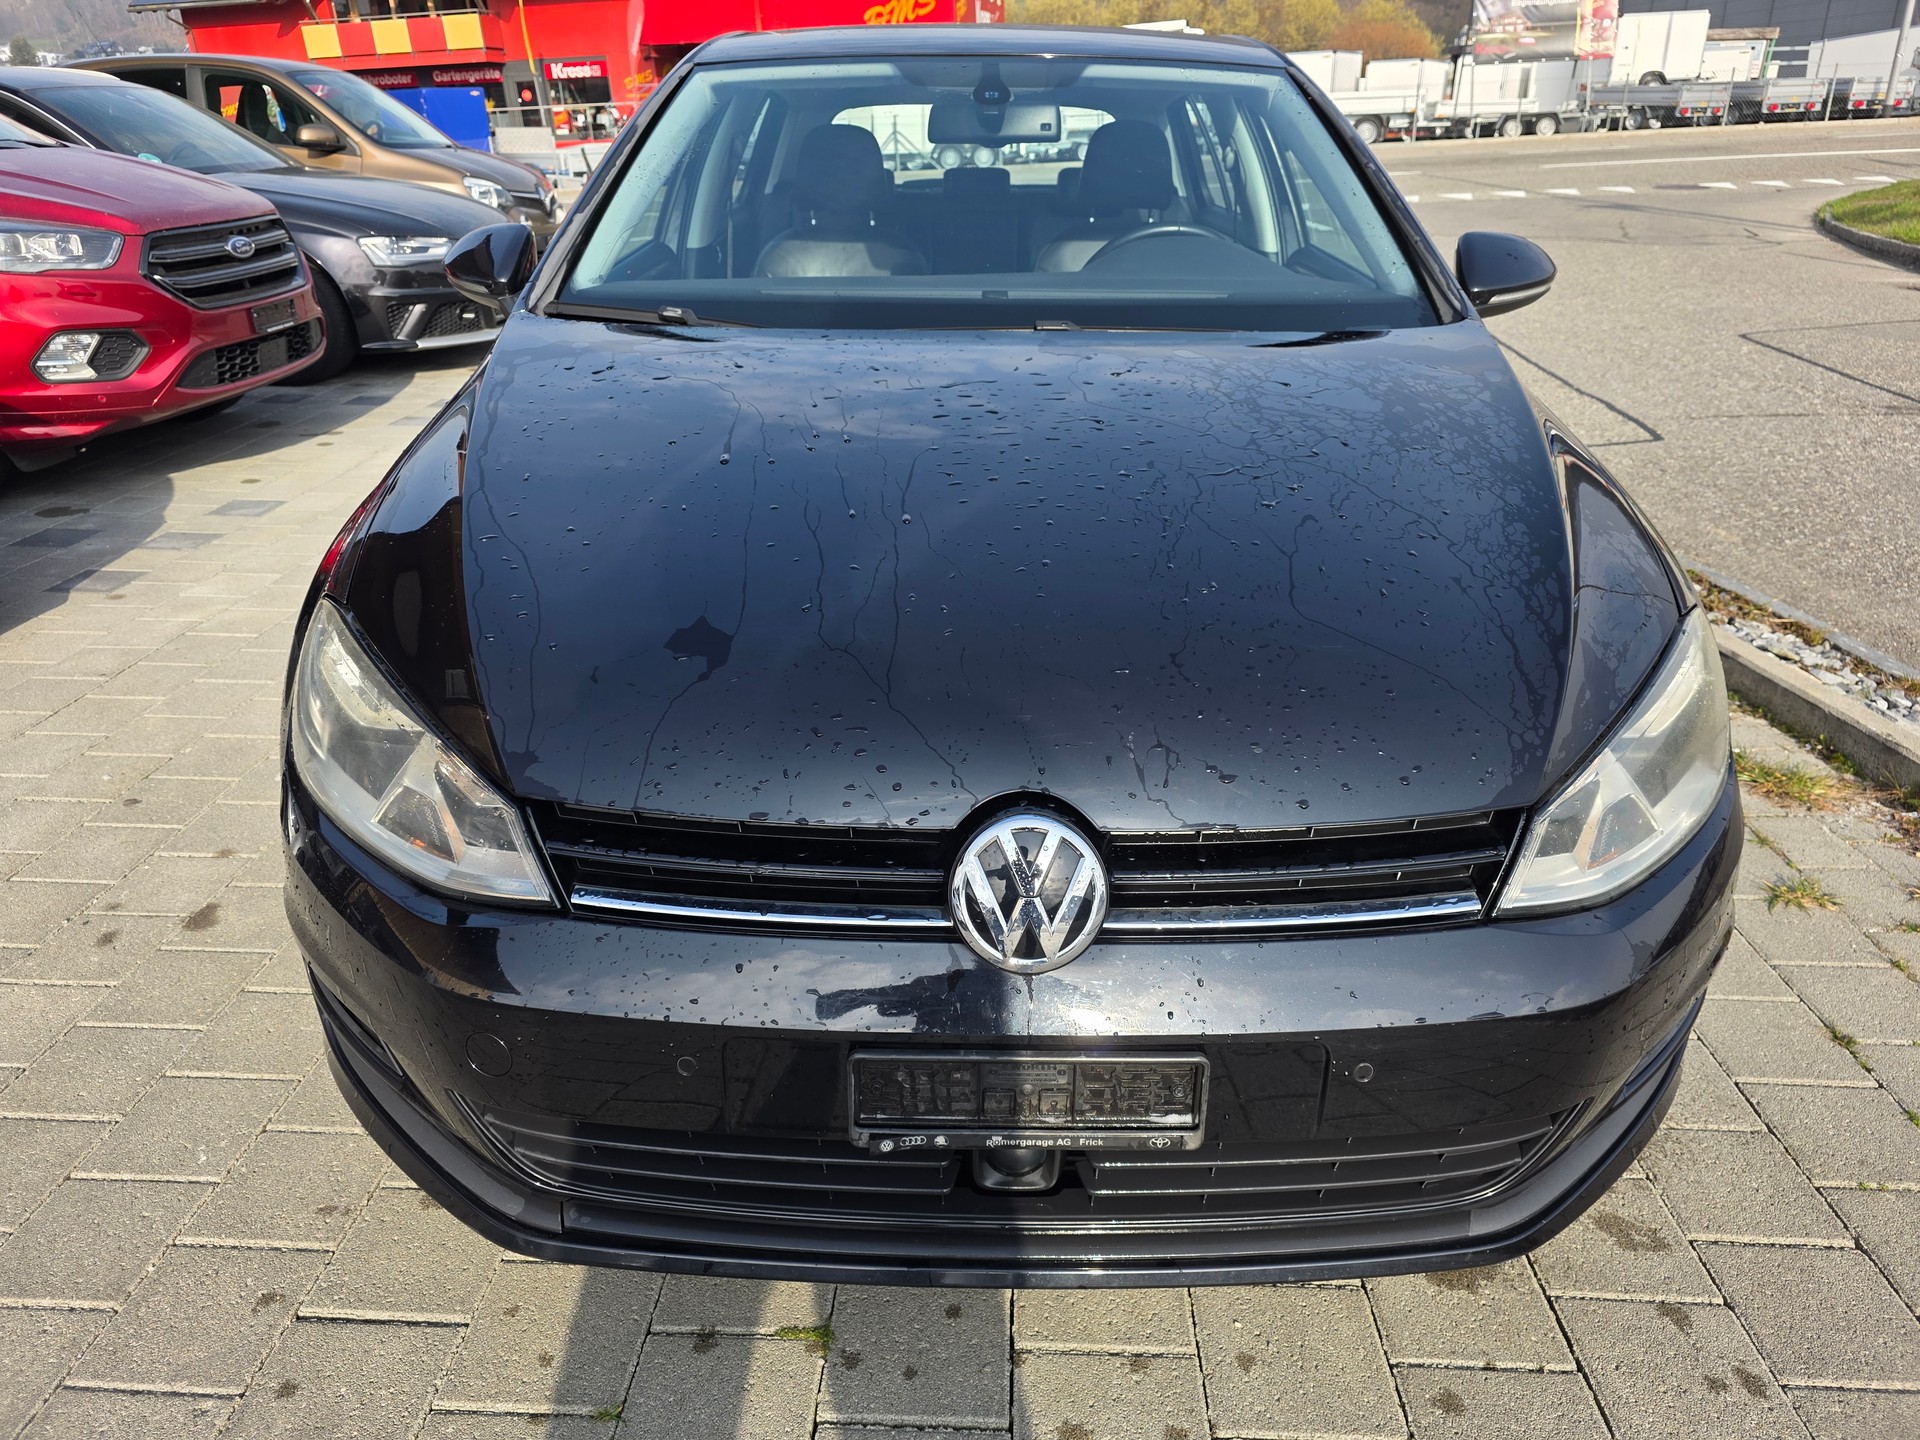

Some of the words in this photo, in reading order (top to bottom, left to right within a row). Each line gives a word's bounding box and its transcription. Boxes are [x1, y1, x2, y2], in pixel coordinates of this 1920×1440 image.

[432, 69, 501, 83] Gartengeräte
[550, 63, 592, 79] Kress
[358, 73, 413, 86] ähroboter
[1056, 1138, 1072, 1146] AG
[1079, 1138, 1104, 1146] Frick
